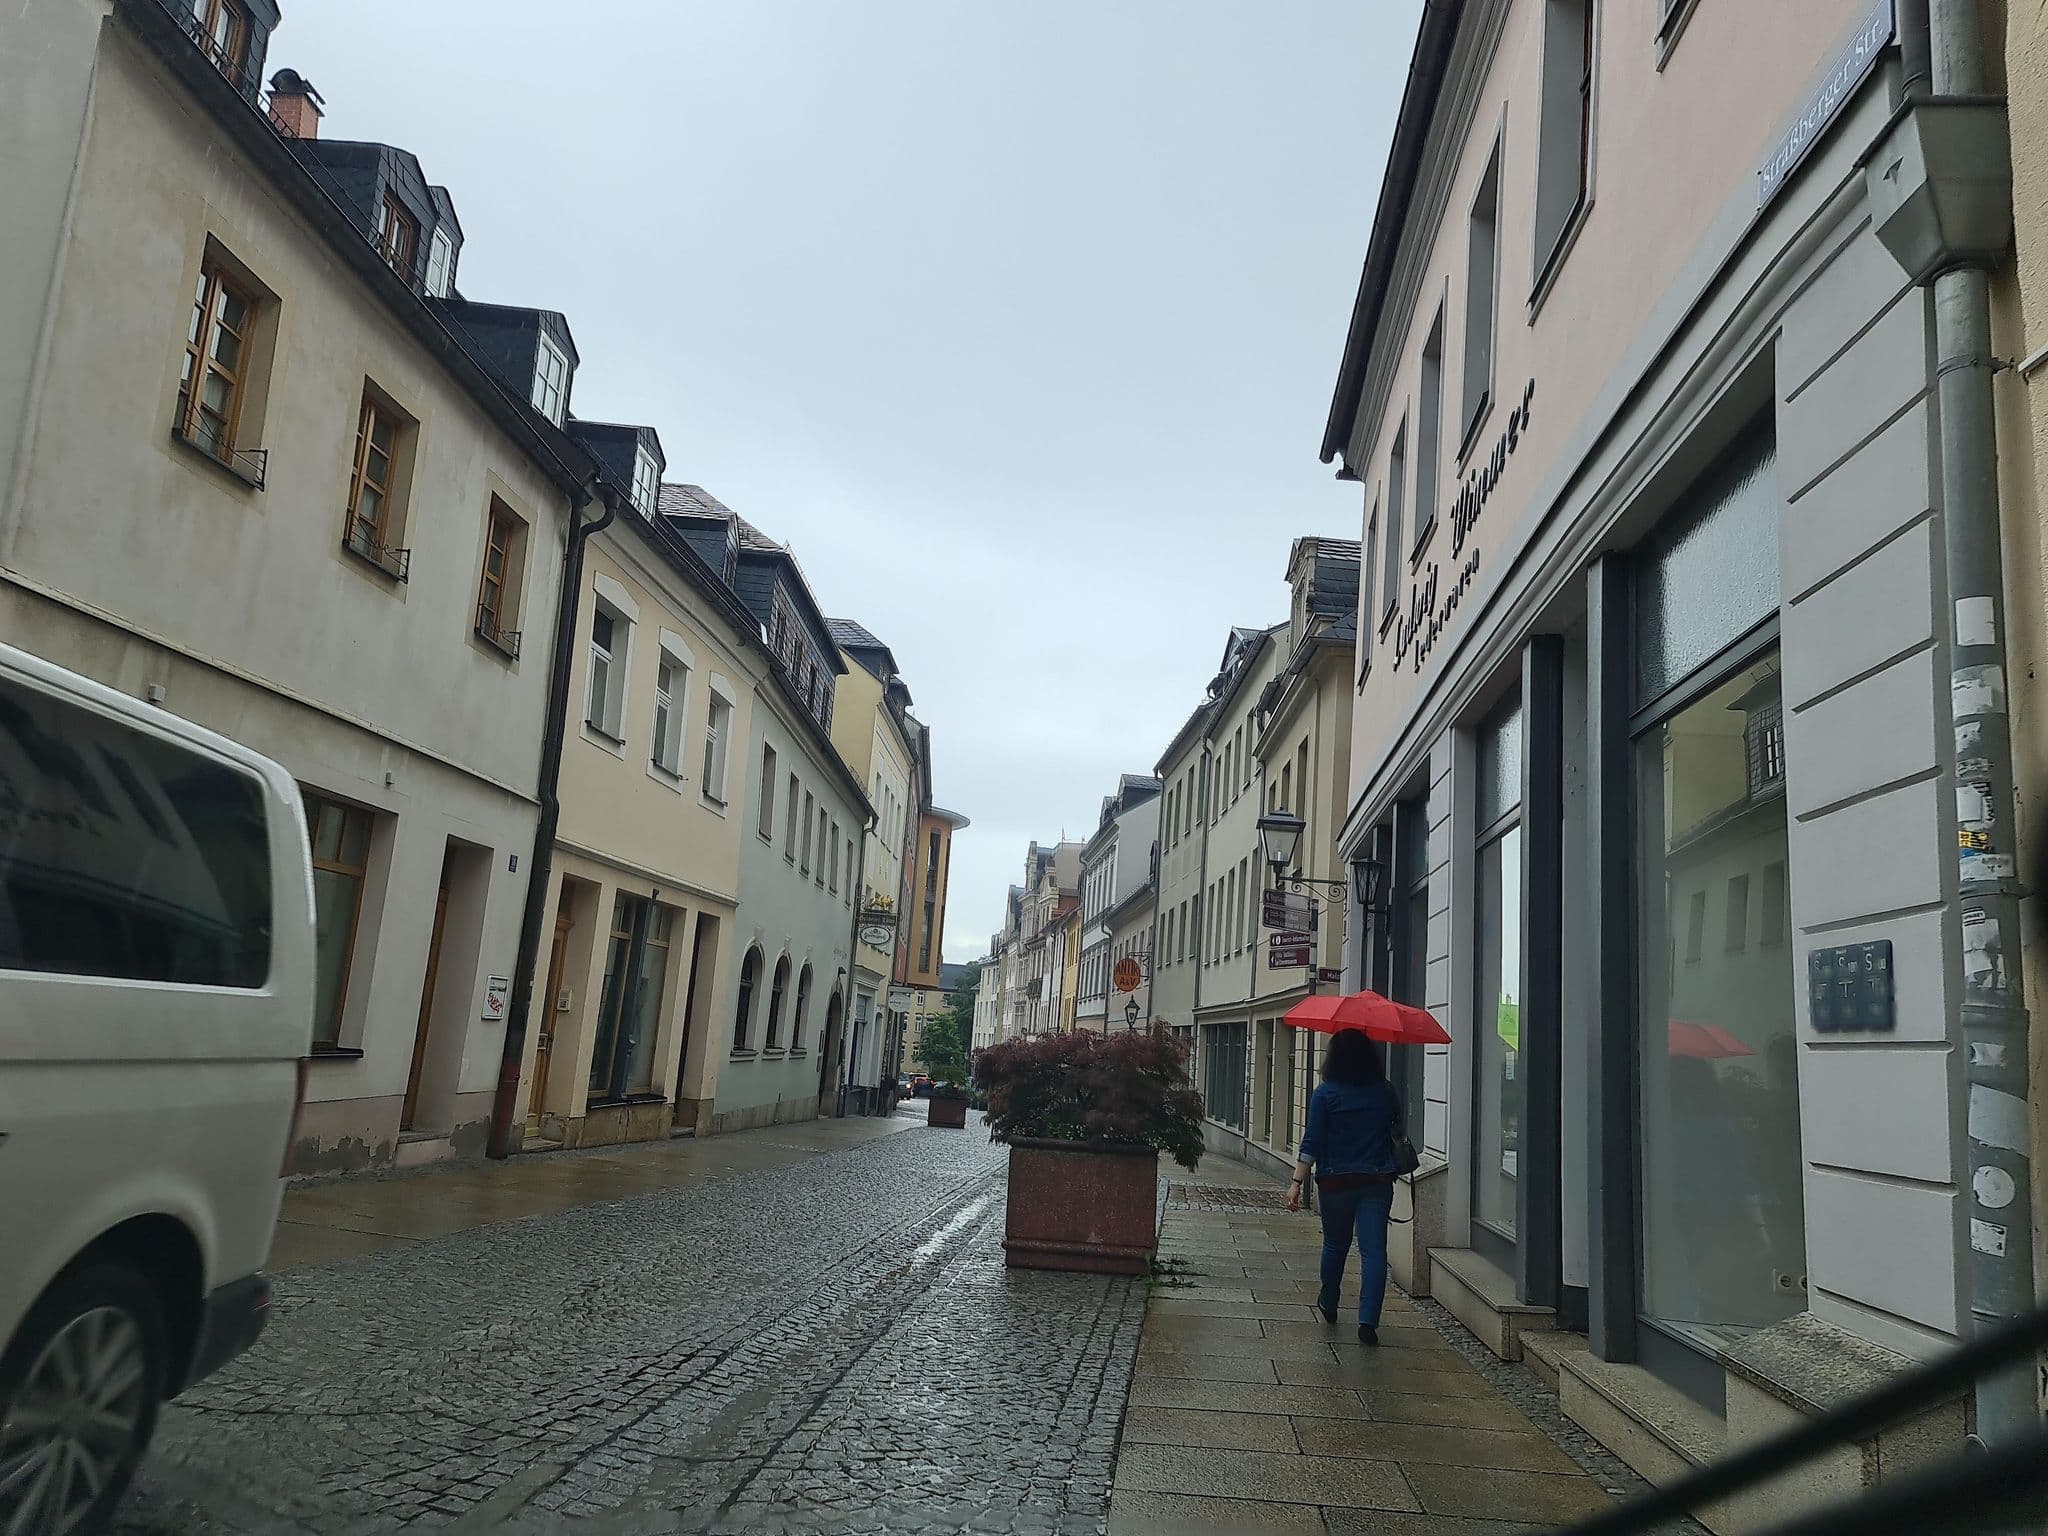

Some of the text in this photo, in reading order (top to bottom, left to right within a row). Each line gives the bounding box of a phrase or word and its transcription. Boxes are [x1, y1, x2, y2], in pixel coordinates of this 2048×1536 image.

[1762, 19, 1884, 192] Straßberger Str.
[1115, 959, 1140, 976] ANTIK
[1120, 976, 1136, 987] A&V
